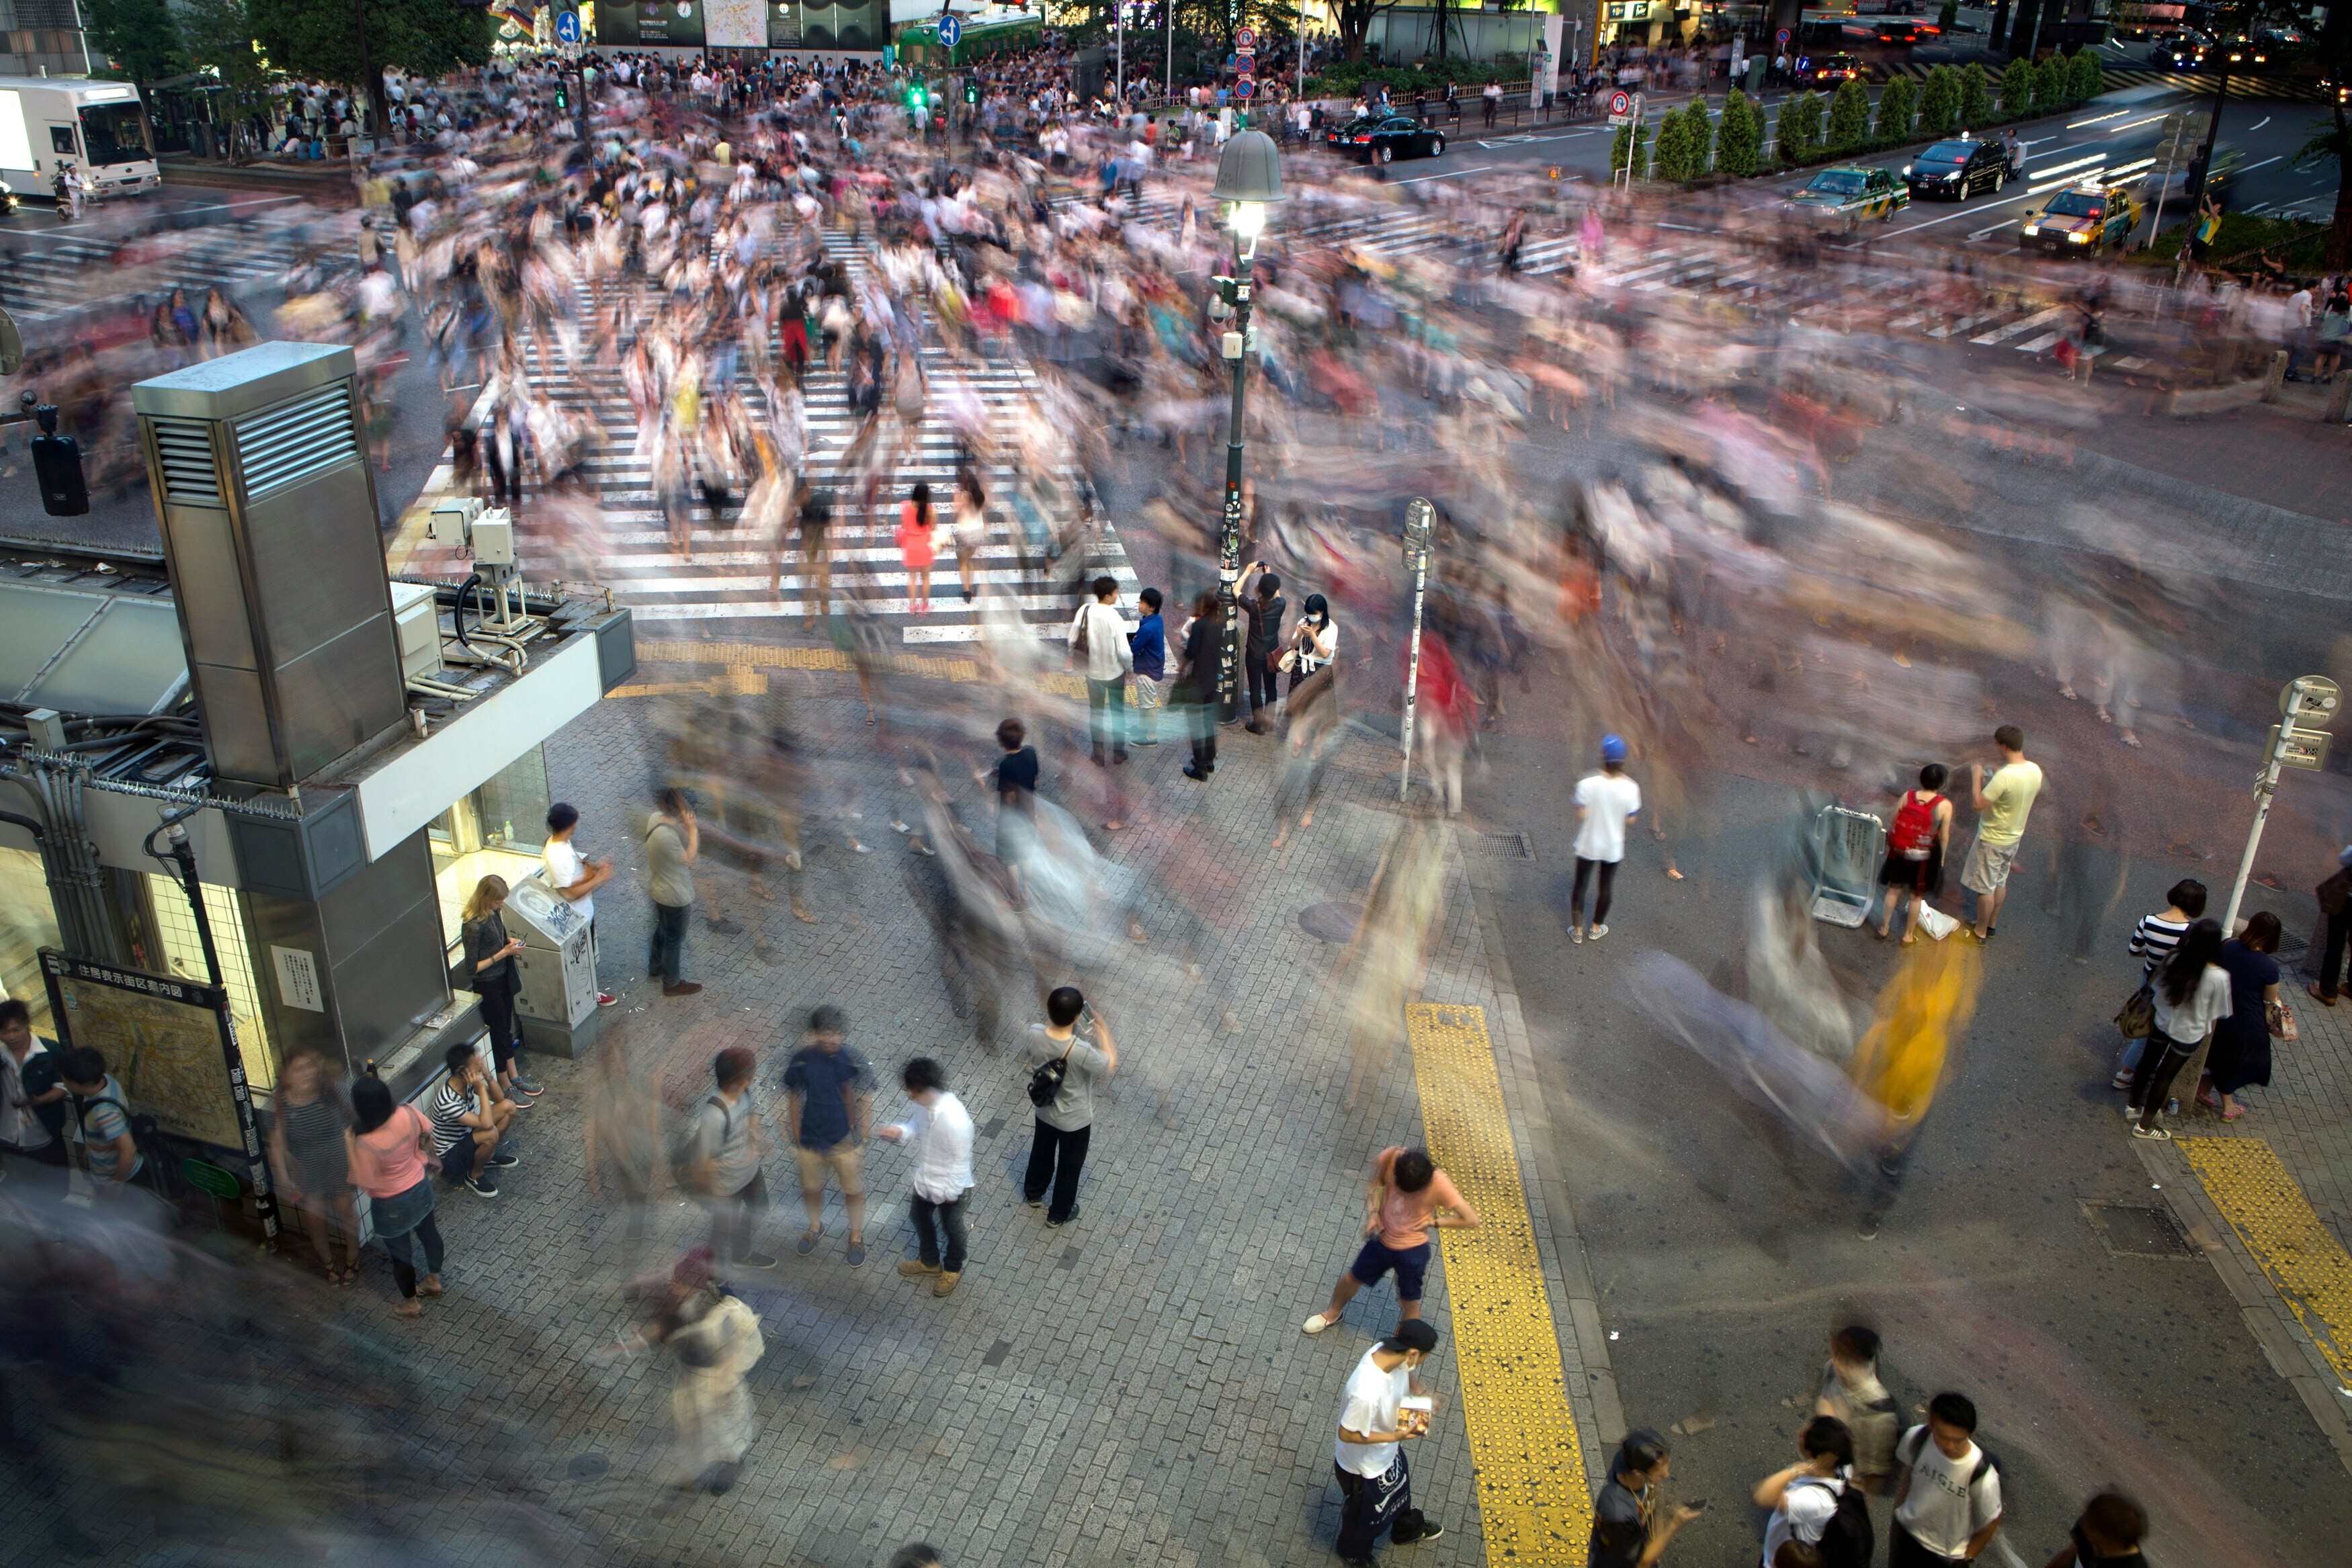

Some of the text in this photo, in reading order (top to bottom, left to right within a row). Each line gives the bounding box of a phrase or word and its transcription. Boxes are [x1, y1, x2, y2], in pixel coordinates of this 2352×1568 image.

[78, 964, 183, 998] 住居表示街区案内図
[1919, 1465, 1966, 1498] AIGLE
